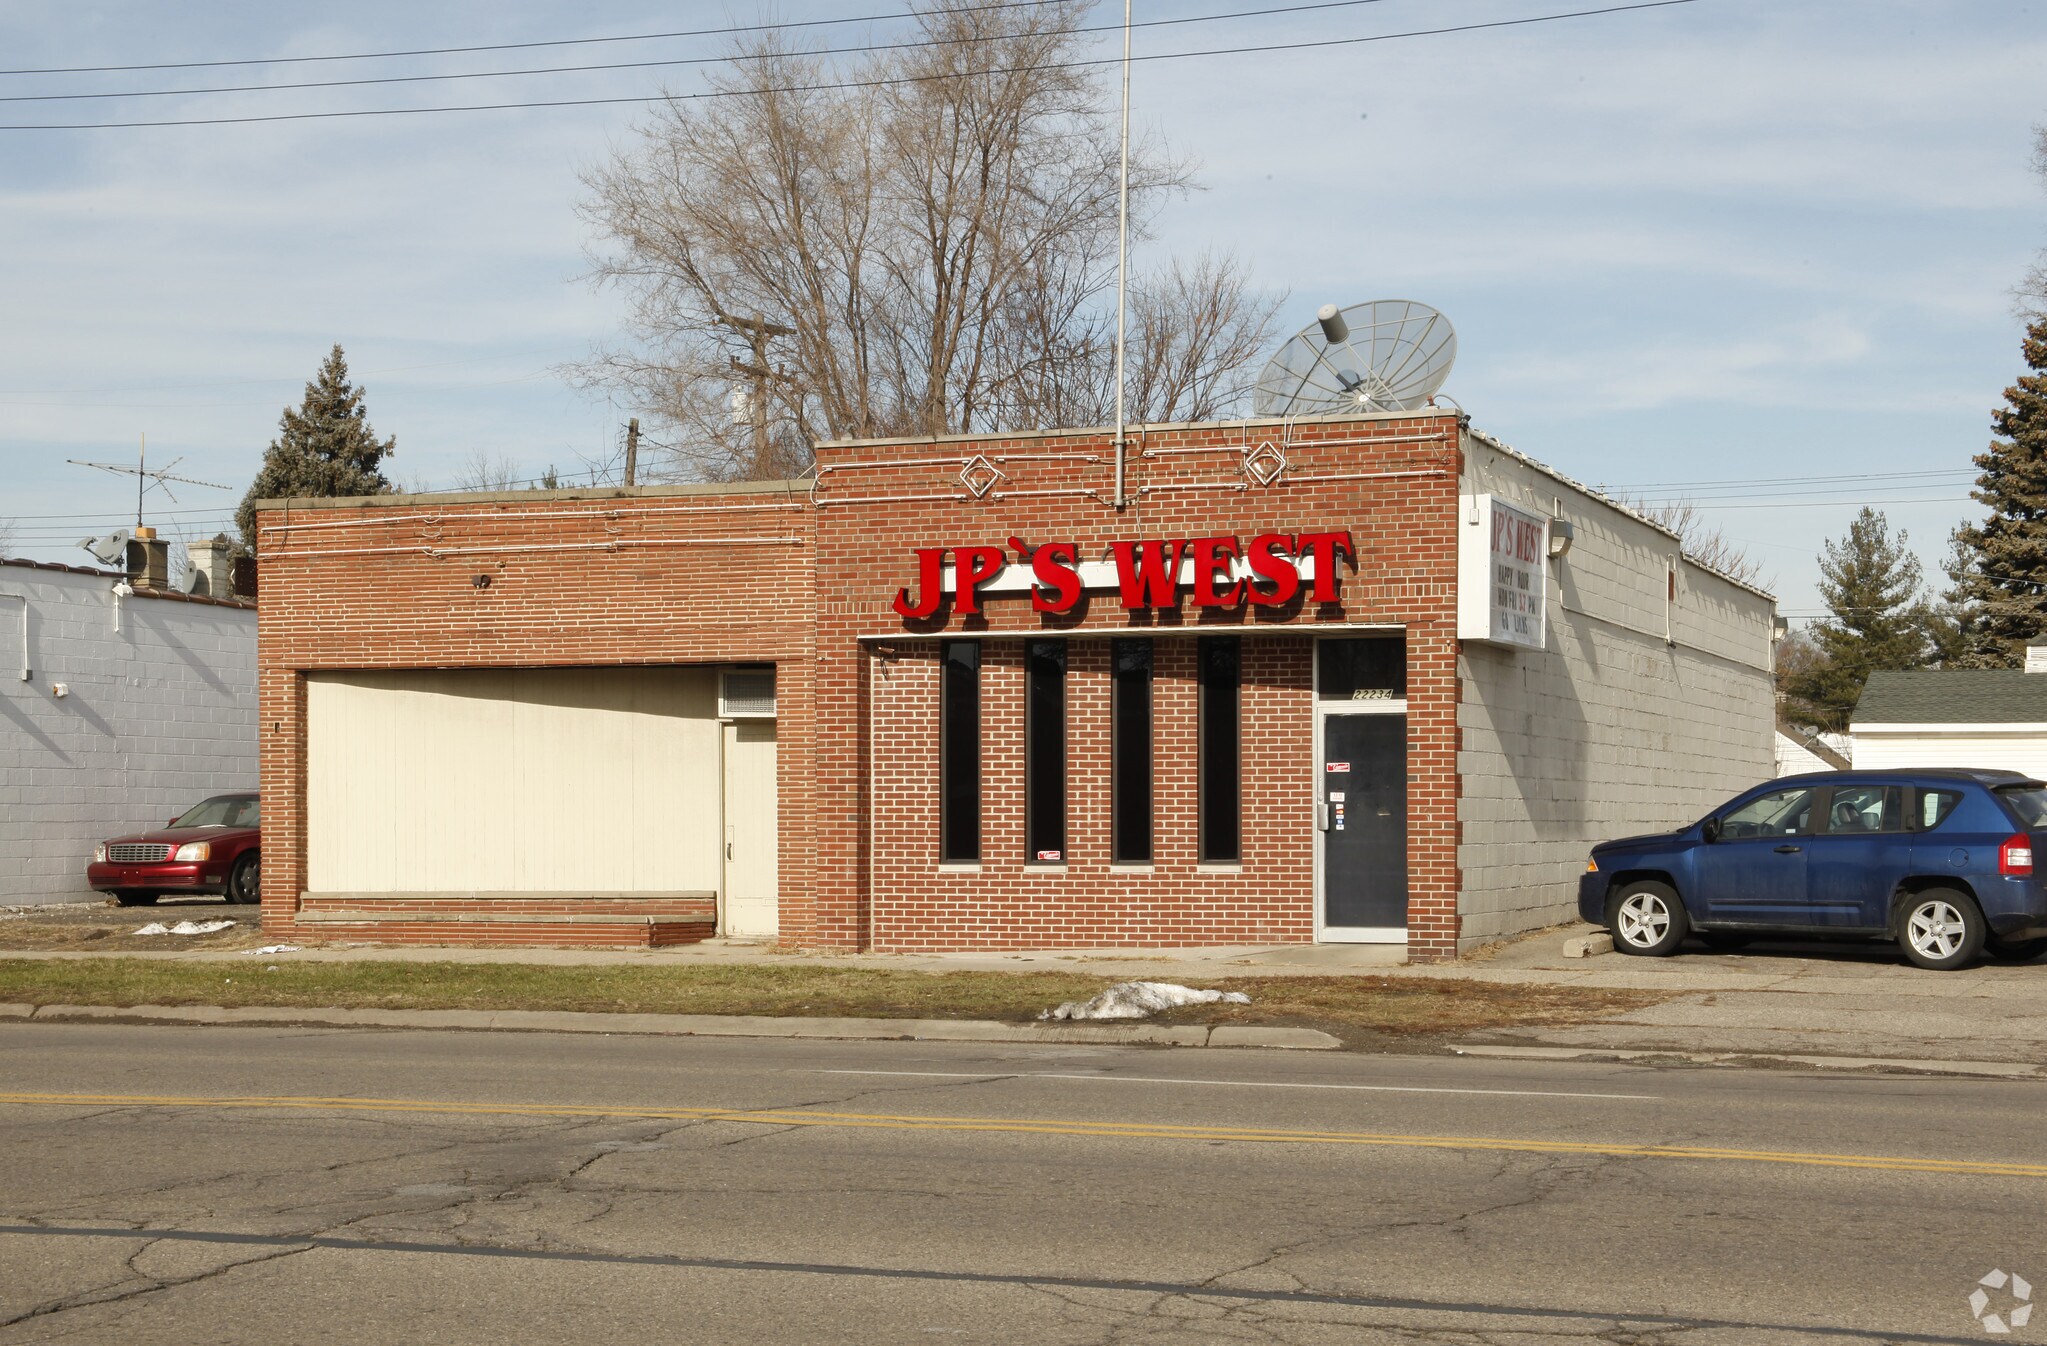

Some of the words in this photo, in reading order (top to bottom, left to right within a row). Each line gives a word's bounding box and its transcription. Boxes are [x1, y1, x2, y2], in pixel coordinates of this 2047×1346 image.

[1491, 510, 1513, 556] JP'S
[1516, 519, 1542, 565] WEST
[892, 536, 1081, 618] JP'S
[1110, 531, 1354, 608] WEST
[1498, 564, 1513, 586] HAPPY
[1517, 570, 1529, 591] HOUR
[1354, 690, 1392, 699] 22234
